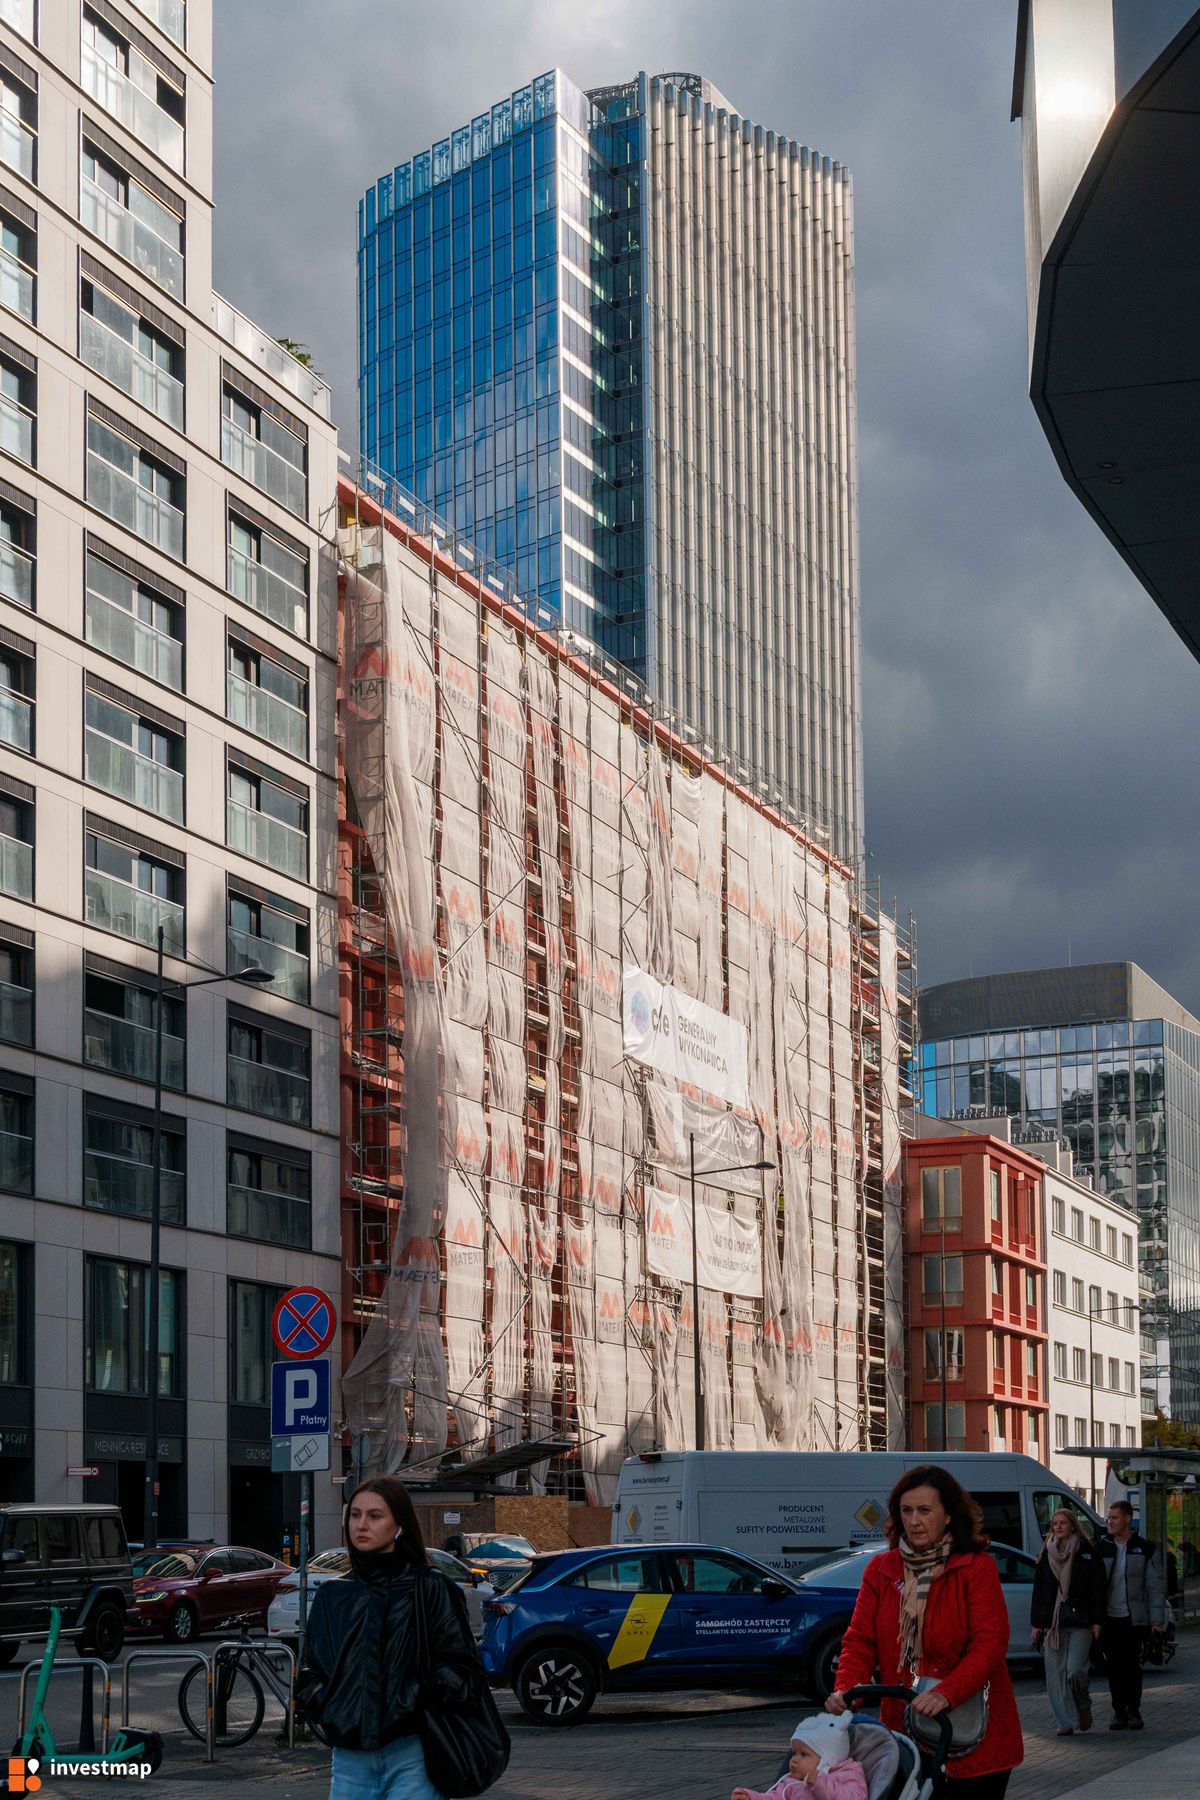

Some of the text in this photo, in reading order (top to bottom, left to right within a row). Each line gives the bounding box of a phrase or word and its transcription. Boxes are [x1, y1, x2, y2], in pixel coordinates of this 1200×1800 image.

[678, 1015, 717, 1049] GENERALNY
[678, 1035, 728, 1074] WYKONAWCA
[285, 1369, 317, 1426] P
[300, 1415, 328, 1427] Płatny
[95, 1441, 130, 1454] MENNICA
[778, 1505, 825, 1513] PRODUCENT
[736, 1525, 826, 1534] SUFITY PODWIESZANE
[695, 1618, 791, 1628] SAMOCHÓD ZASTĘPCZY
